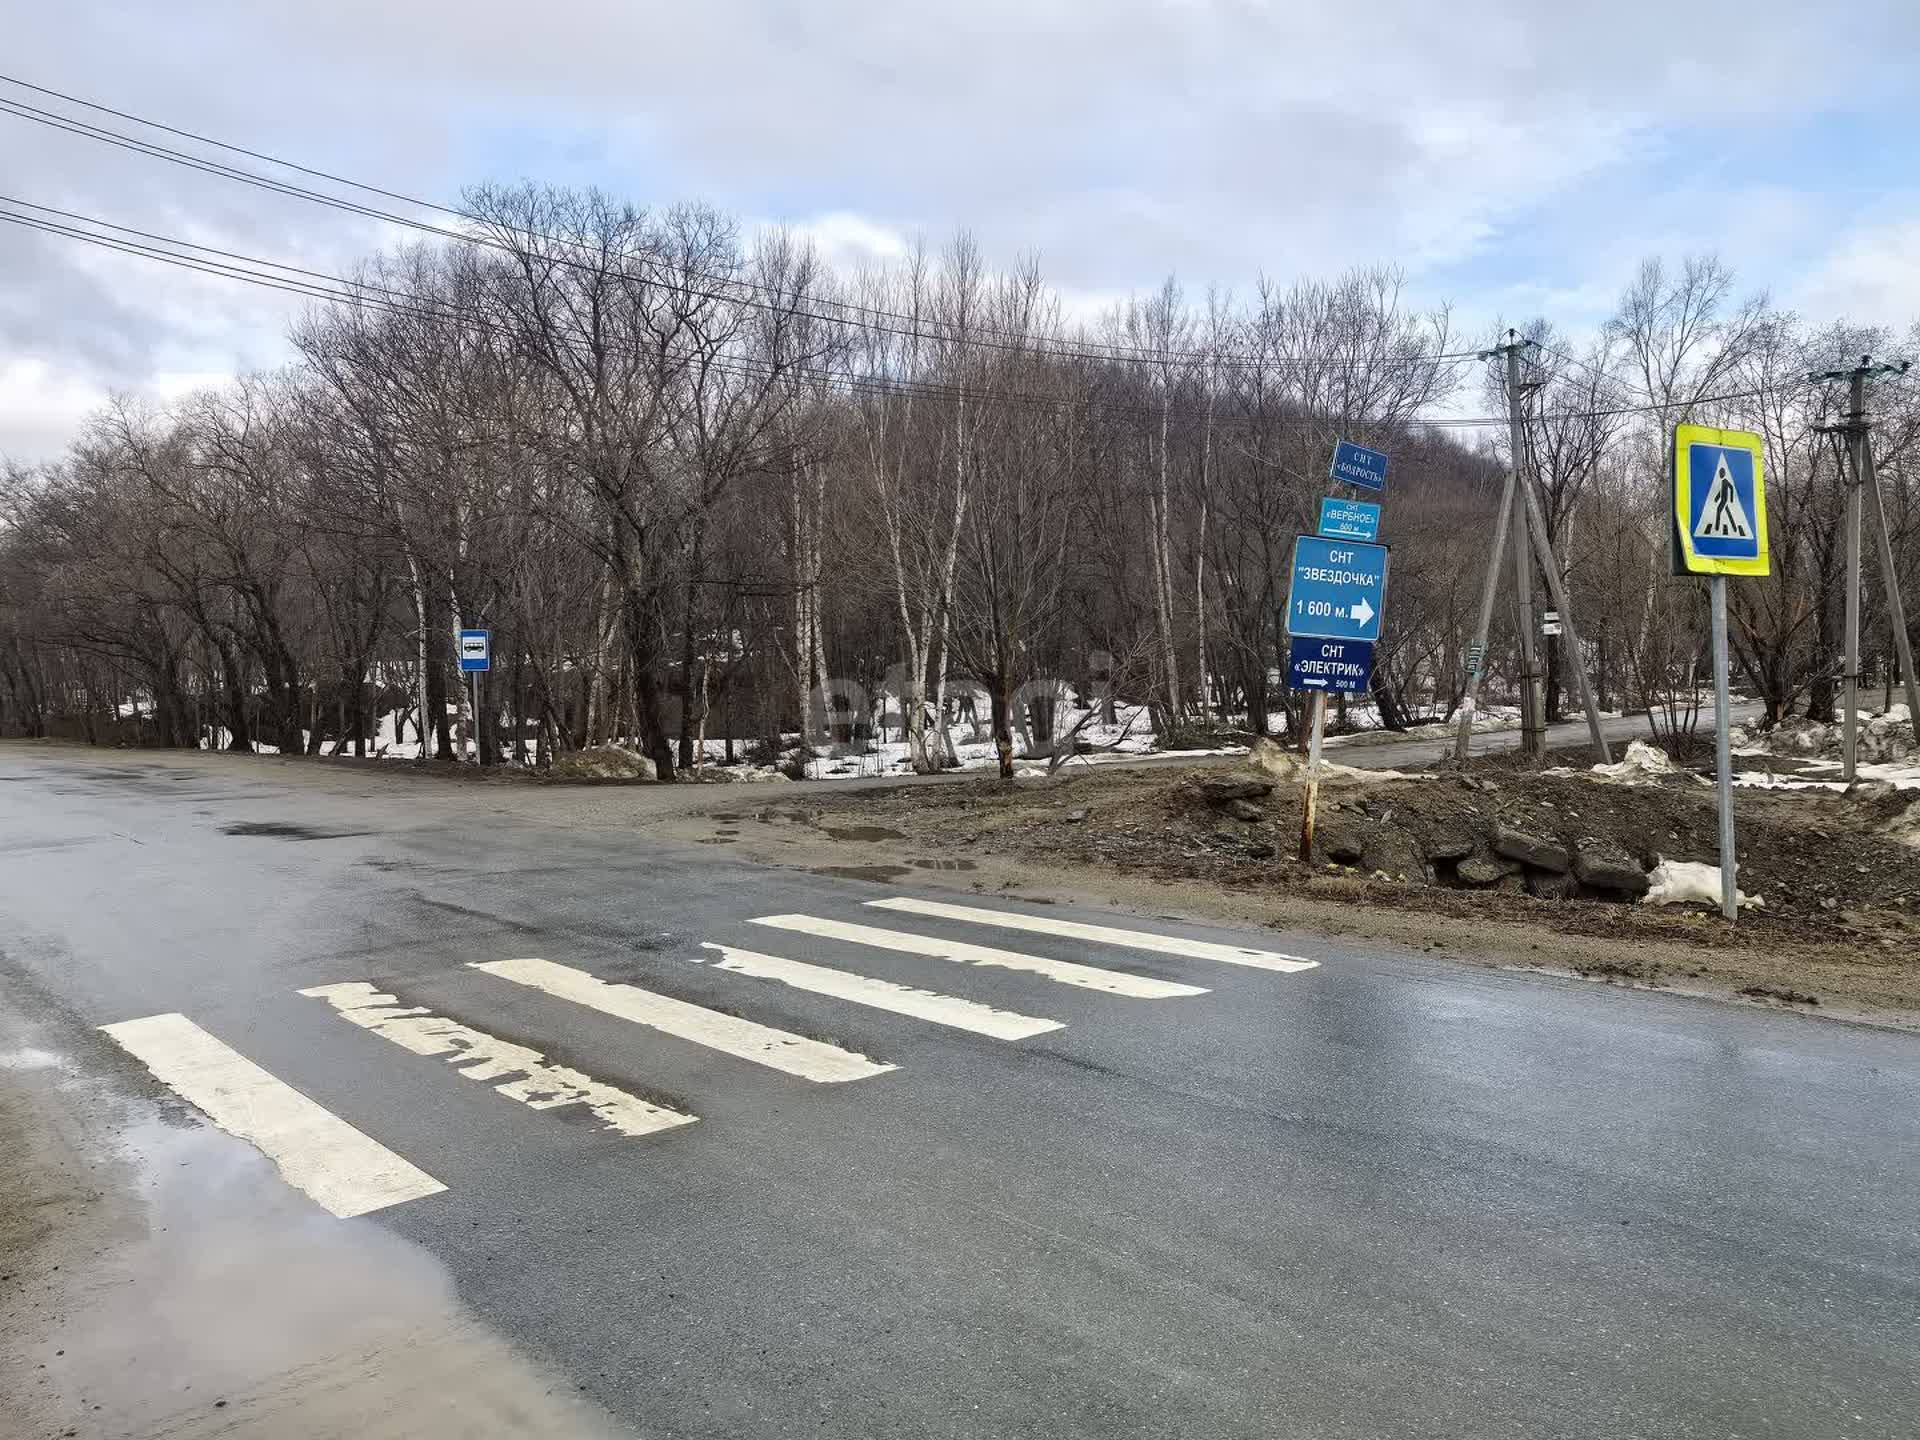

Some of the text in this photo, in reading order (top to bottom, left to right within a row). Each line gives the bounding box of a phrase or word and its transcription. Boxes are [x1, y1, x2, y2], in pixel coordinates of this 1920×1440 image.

[1354, 452, 1372, 465] СНТ
[1336, 462, 1382, 481] «БОДРОСТЬ»
[1327, 509, 1375, 523] «ВЕРБНОЕ»
[1329, 550, 1354, 564] СНТ
[1298, 566, 1380, 586] "ЗВЕЗДОЧКА"
[1335, 607, 1349, 618] м.
[1321, 644, 1345, 657] СНТ
[1294, 659, 1365, 677] «ЭЛЕКТРИК»
[1335, 679, 1348, 689] 500
